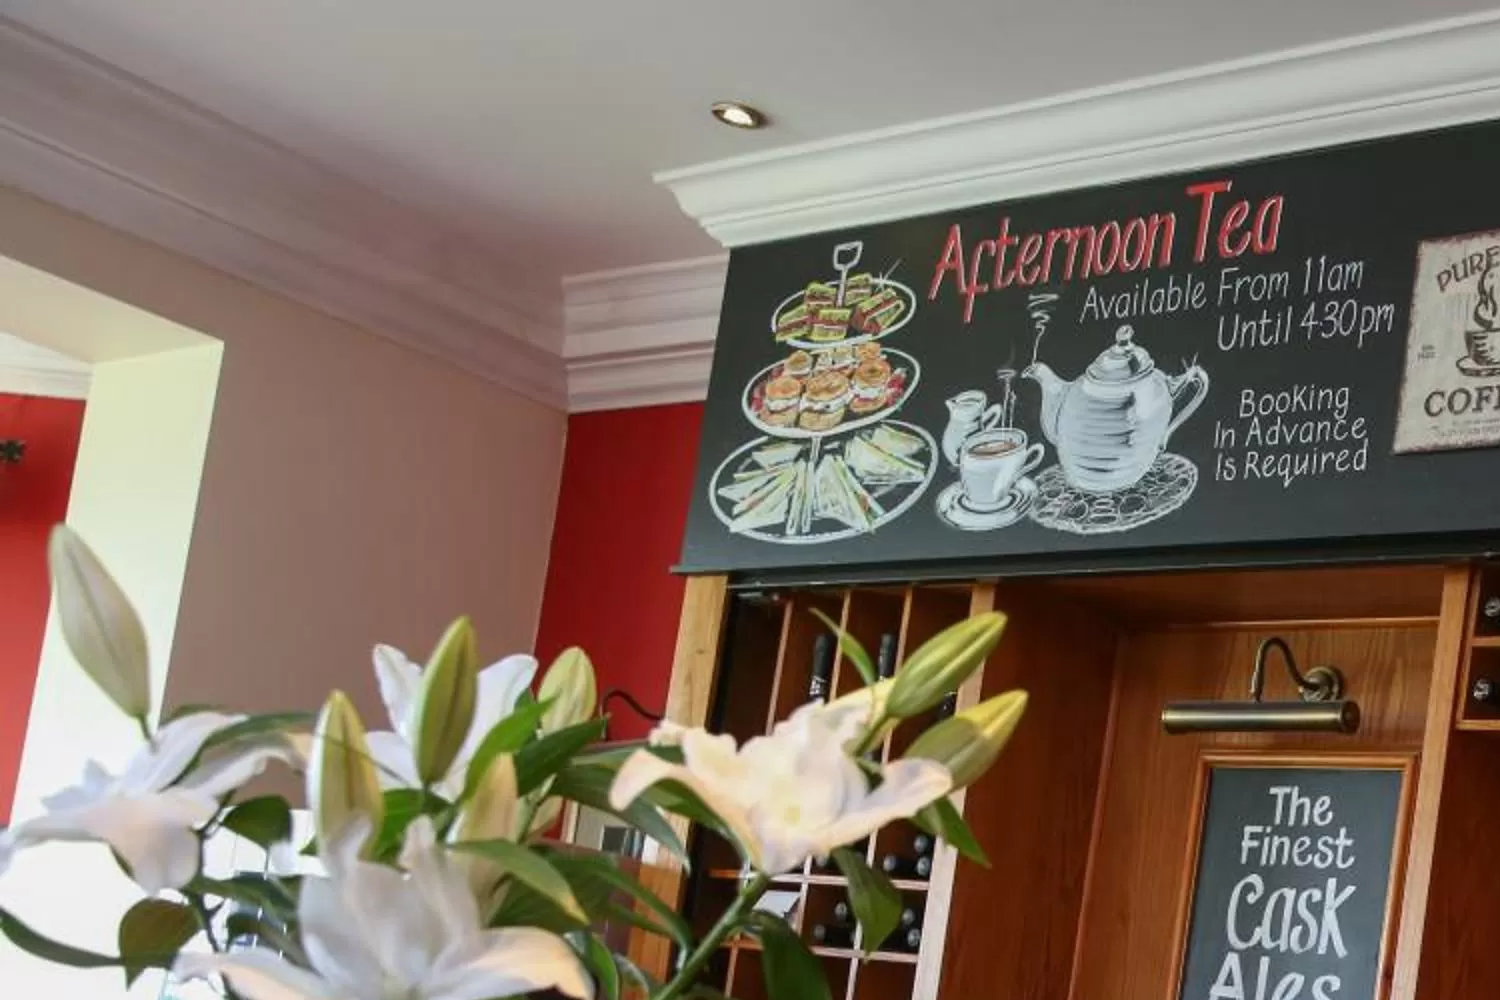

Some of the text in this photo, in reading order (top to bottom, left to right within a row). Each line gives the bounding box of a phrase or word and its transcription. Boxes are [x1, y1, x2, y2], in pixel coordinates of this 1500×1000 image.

[927, 179, 1285, 325] Afternoon Tea
[1078, 254, 1365, 325] Available From 11am
[1216, 304, 1293, 351] Until
[1213, 415, 1369, 449] In Advance
[1214, 436, 1370, 489] Is Required
[1267, 784, 1334, 829] The
[1239, 823, 1356, 870] Finest
